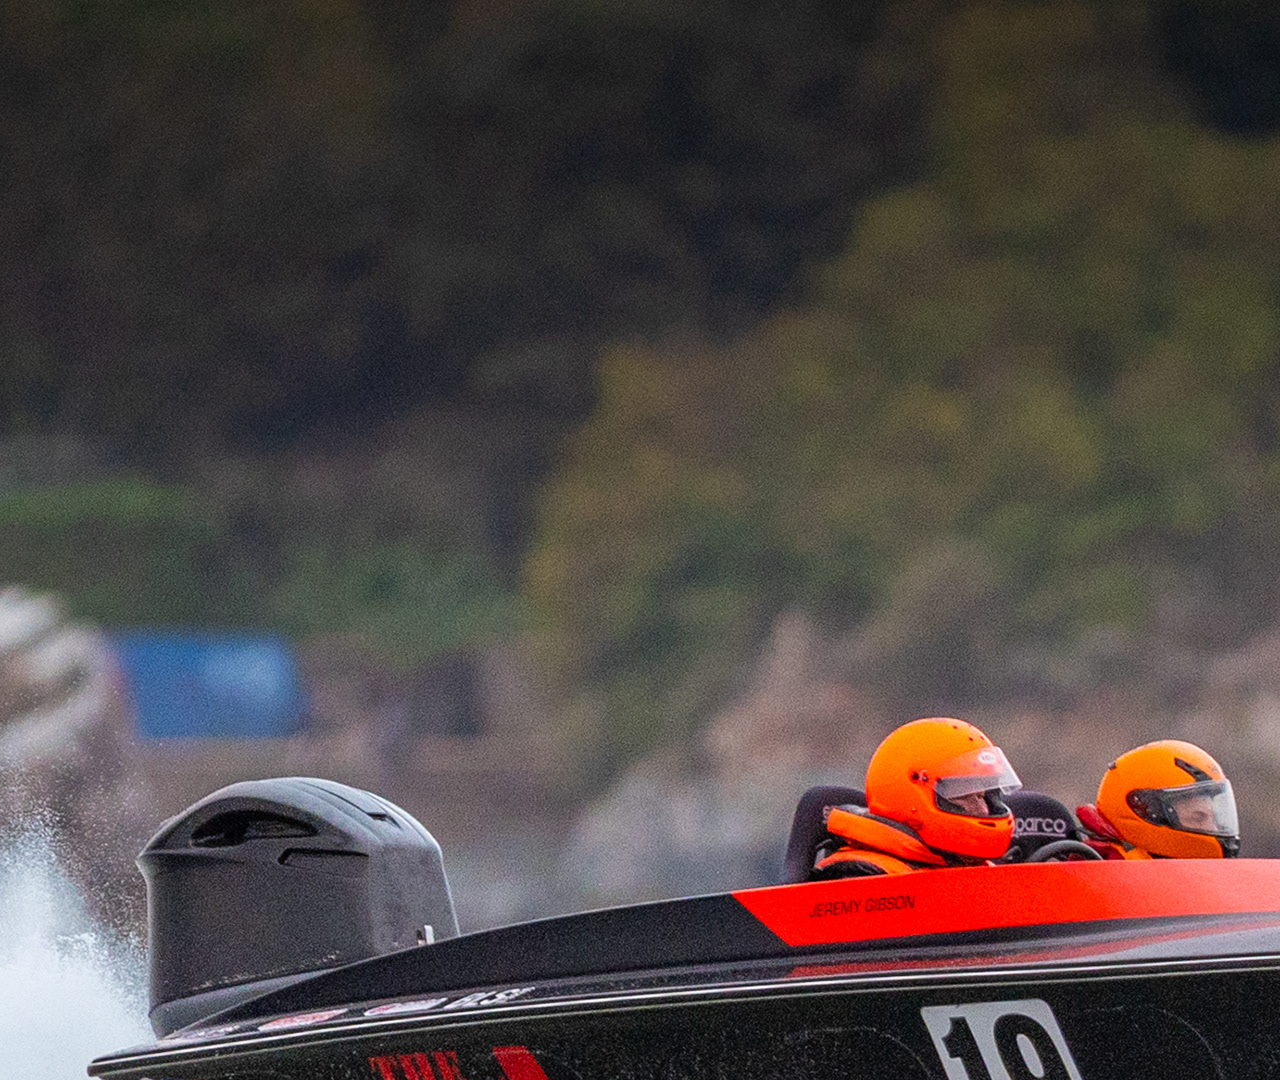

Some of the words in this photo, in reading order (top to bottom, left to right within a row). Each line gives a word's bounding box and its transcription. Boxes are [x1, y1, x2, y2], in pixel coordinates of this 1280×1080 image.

[1013, 817, 1067, 838] parco
[809, 900, 861, 917] JEREMY
[865, 895, 916, 912] GIBSON
